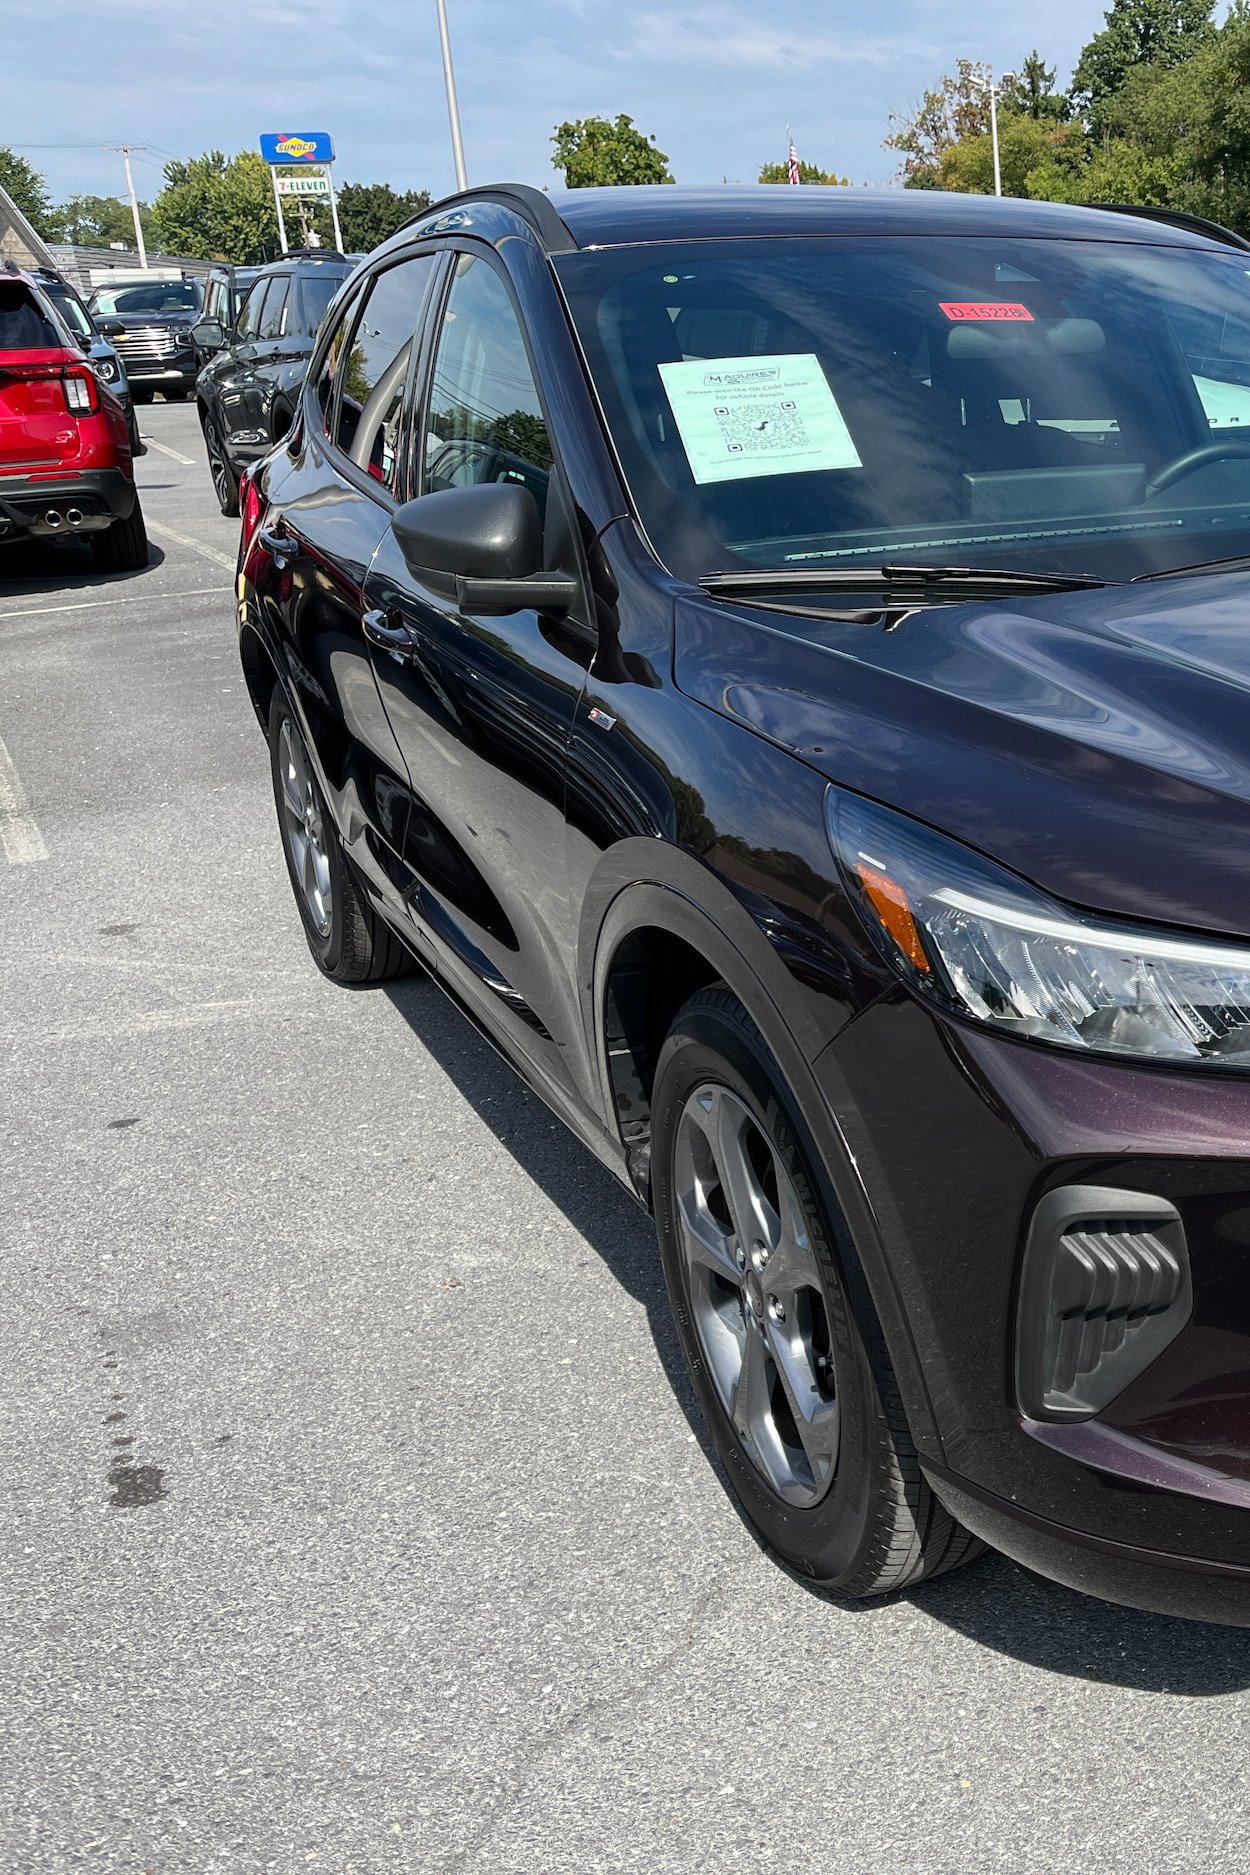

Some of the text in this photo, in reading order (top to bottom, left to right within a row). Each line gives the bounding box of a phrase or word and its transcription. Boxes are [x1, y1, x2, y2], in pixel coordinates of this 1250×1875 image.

[278, 143, 315, 151] SUNOCO
[279, 181, 326, 191] 7-ELEVEN
[762, 383, 783, 391] Code
[794, 1172, 850, 1349] MICHELIN
